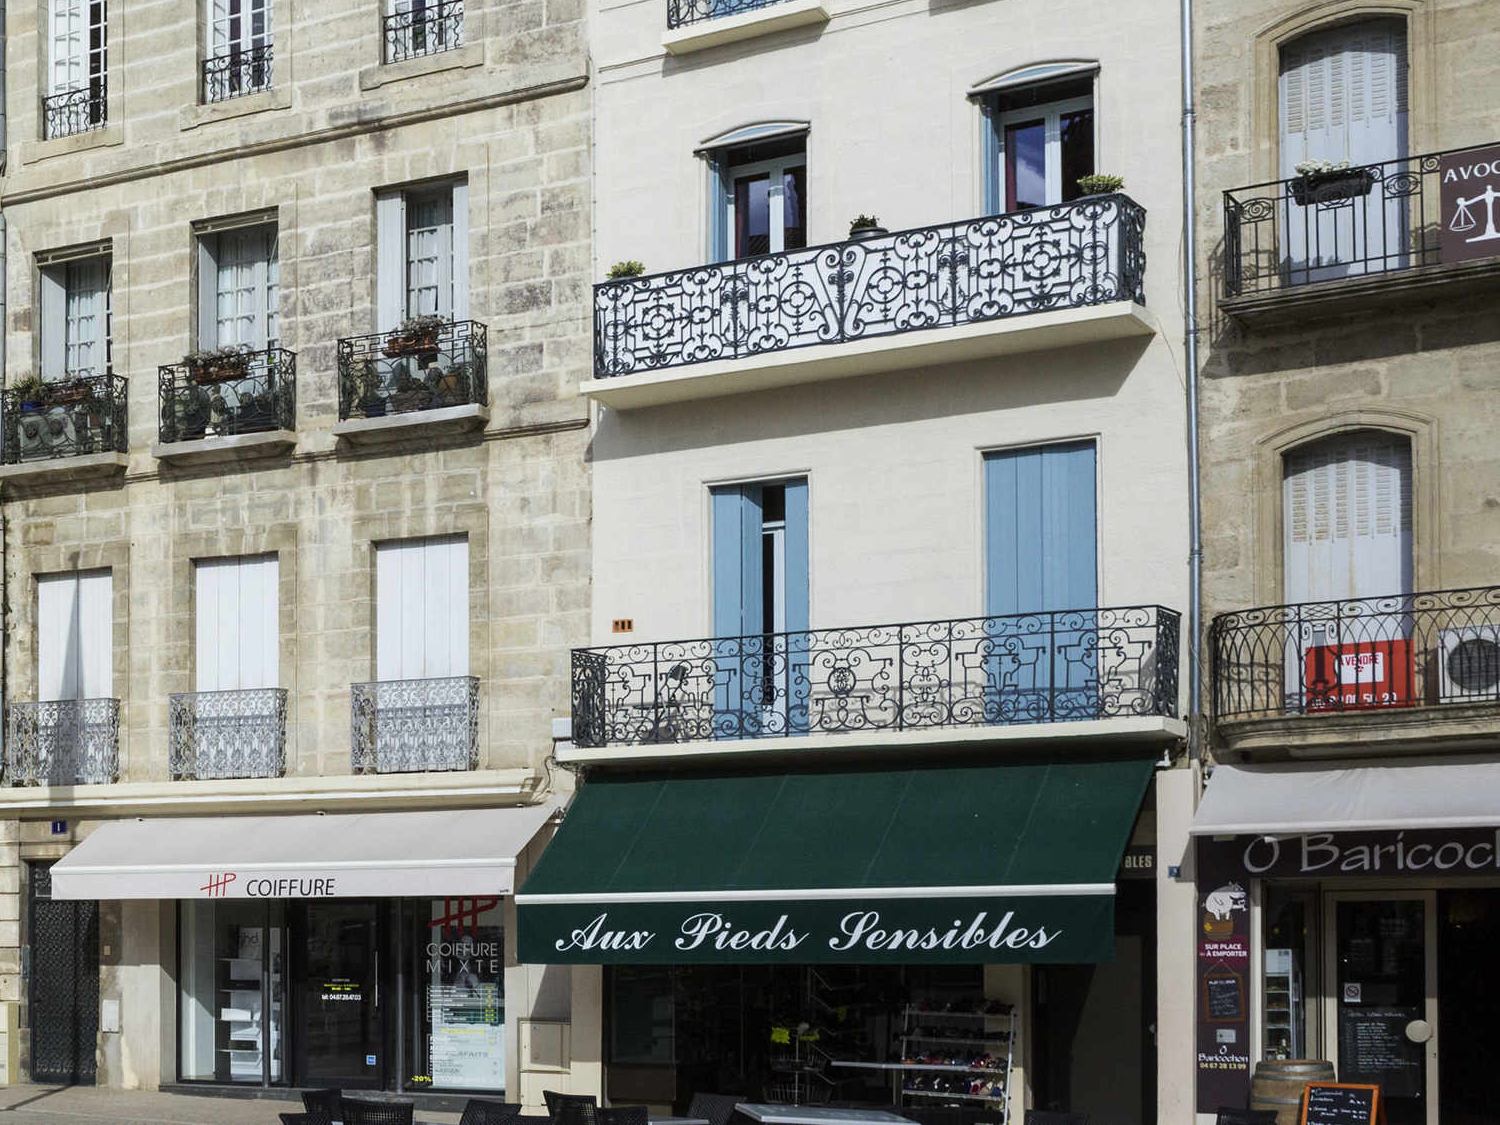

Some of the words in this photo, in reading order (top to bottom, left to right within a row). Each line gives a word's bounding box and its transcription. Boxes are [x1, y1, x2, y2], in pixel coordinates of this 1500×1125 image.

[1299, 828, 1500, 872] Baricoc
[246, 878, 336, 896] COIFFURE
[555, 912, 656, 952] Aux
[674, 912, 810, 951] Pieds
[828, 911, 1063, 951] Sensibles
[426, 942, 499, 957] COIFFURE
[426, 959, 499, 974] MIXTE
